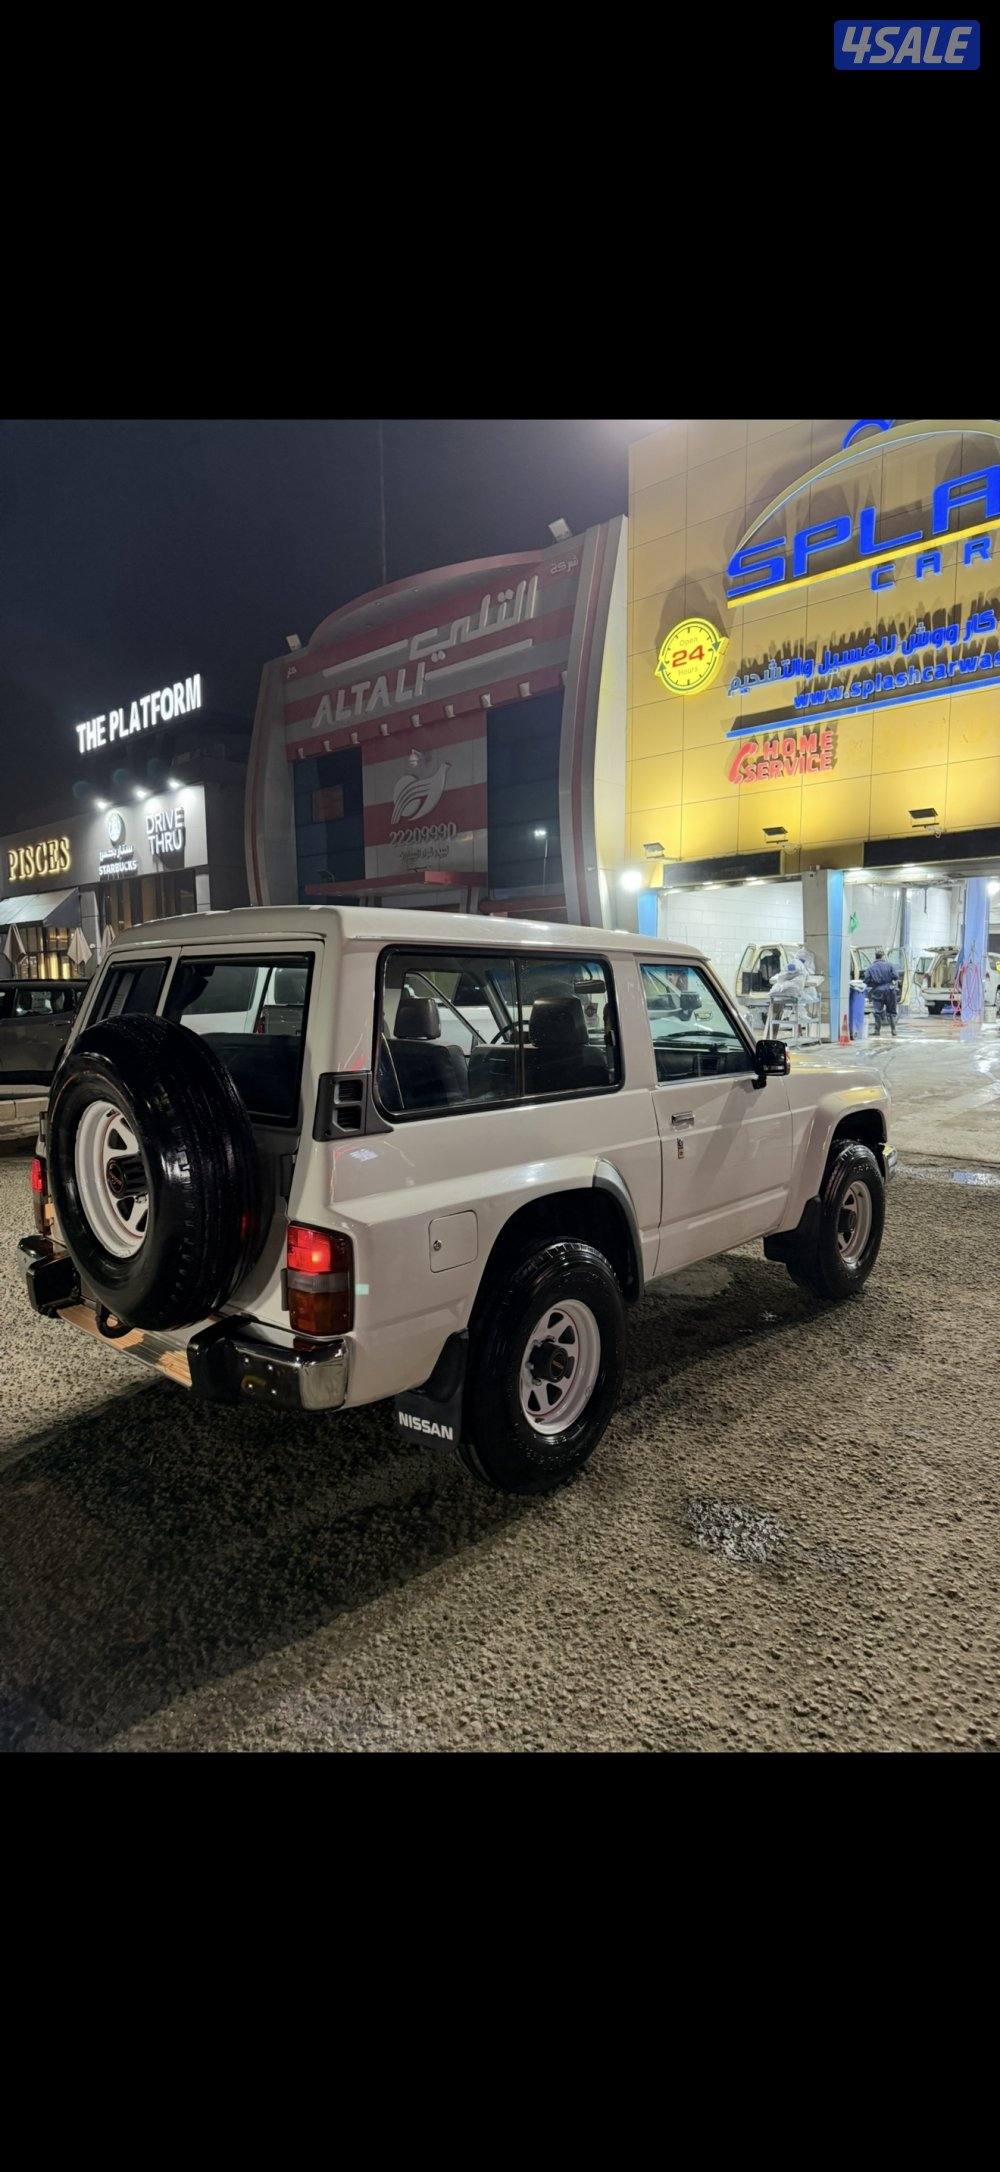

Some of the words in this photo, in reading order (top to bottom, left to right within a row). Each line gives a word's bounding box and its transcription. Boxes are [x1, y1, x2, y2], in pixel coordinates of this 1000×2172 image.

[726, 463, 1000, 598] SPLA
[869, 534, 992, 593] CAR
[672, 645, 704, 667] 24
[817, 633, 898, 675] للغسيل
[727, 657, 815, 697] والتشحيم
[312, 661, 425, 729] ALTALI
[76, 714, 107, 753] THE
[109, 673, 202, 742] PLATFORM
[763, 732, 833, 760] HOME
[741, 752, 832, 783] SERVICE
[146, 808, 185, 833] DRIVE
[8, 836, 72, 881] PISCES
[148, 829, 184, 854] THRU
[99, 860, 138, 876] STARBUCKS
[399, 1411, 453, 1440] NISSAN
